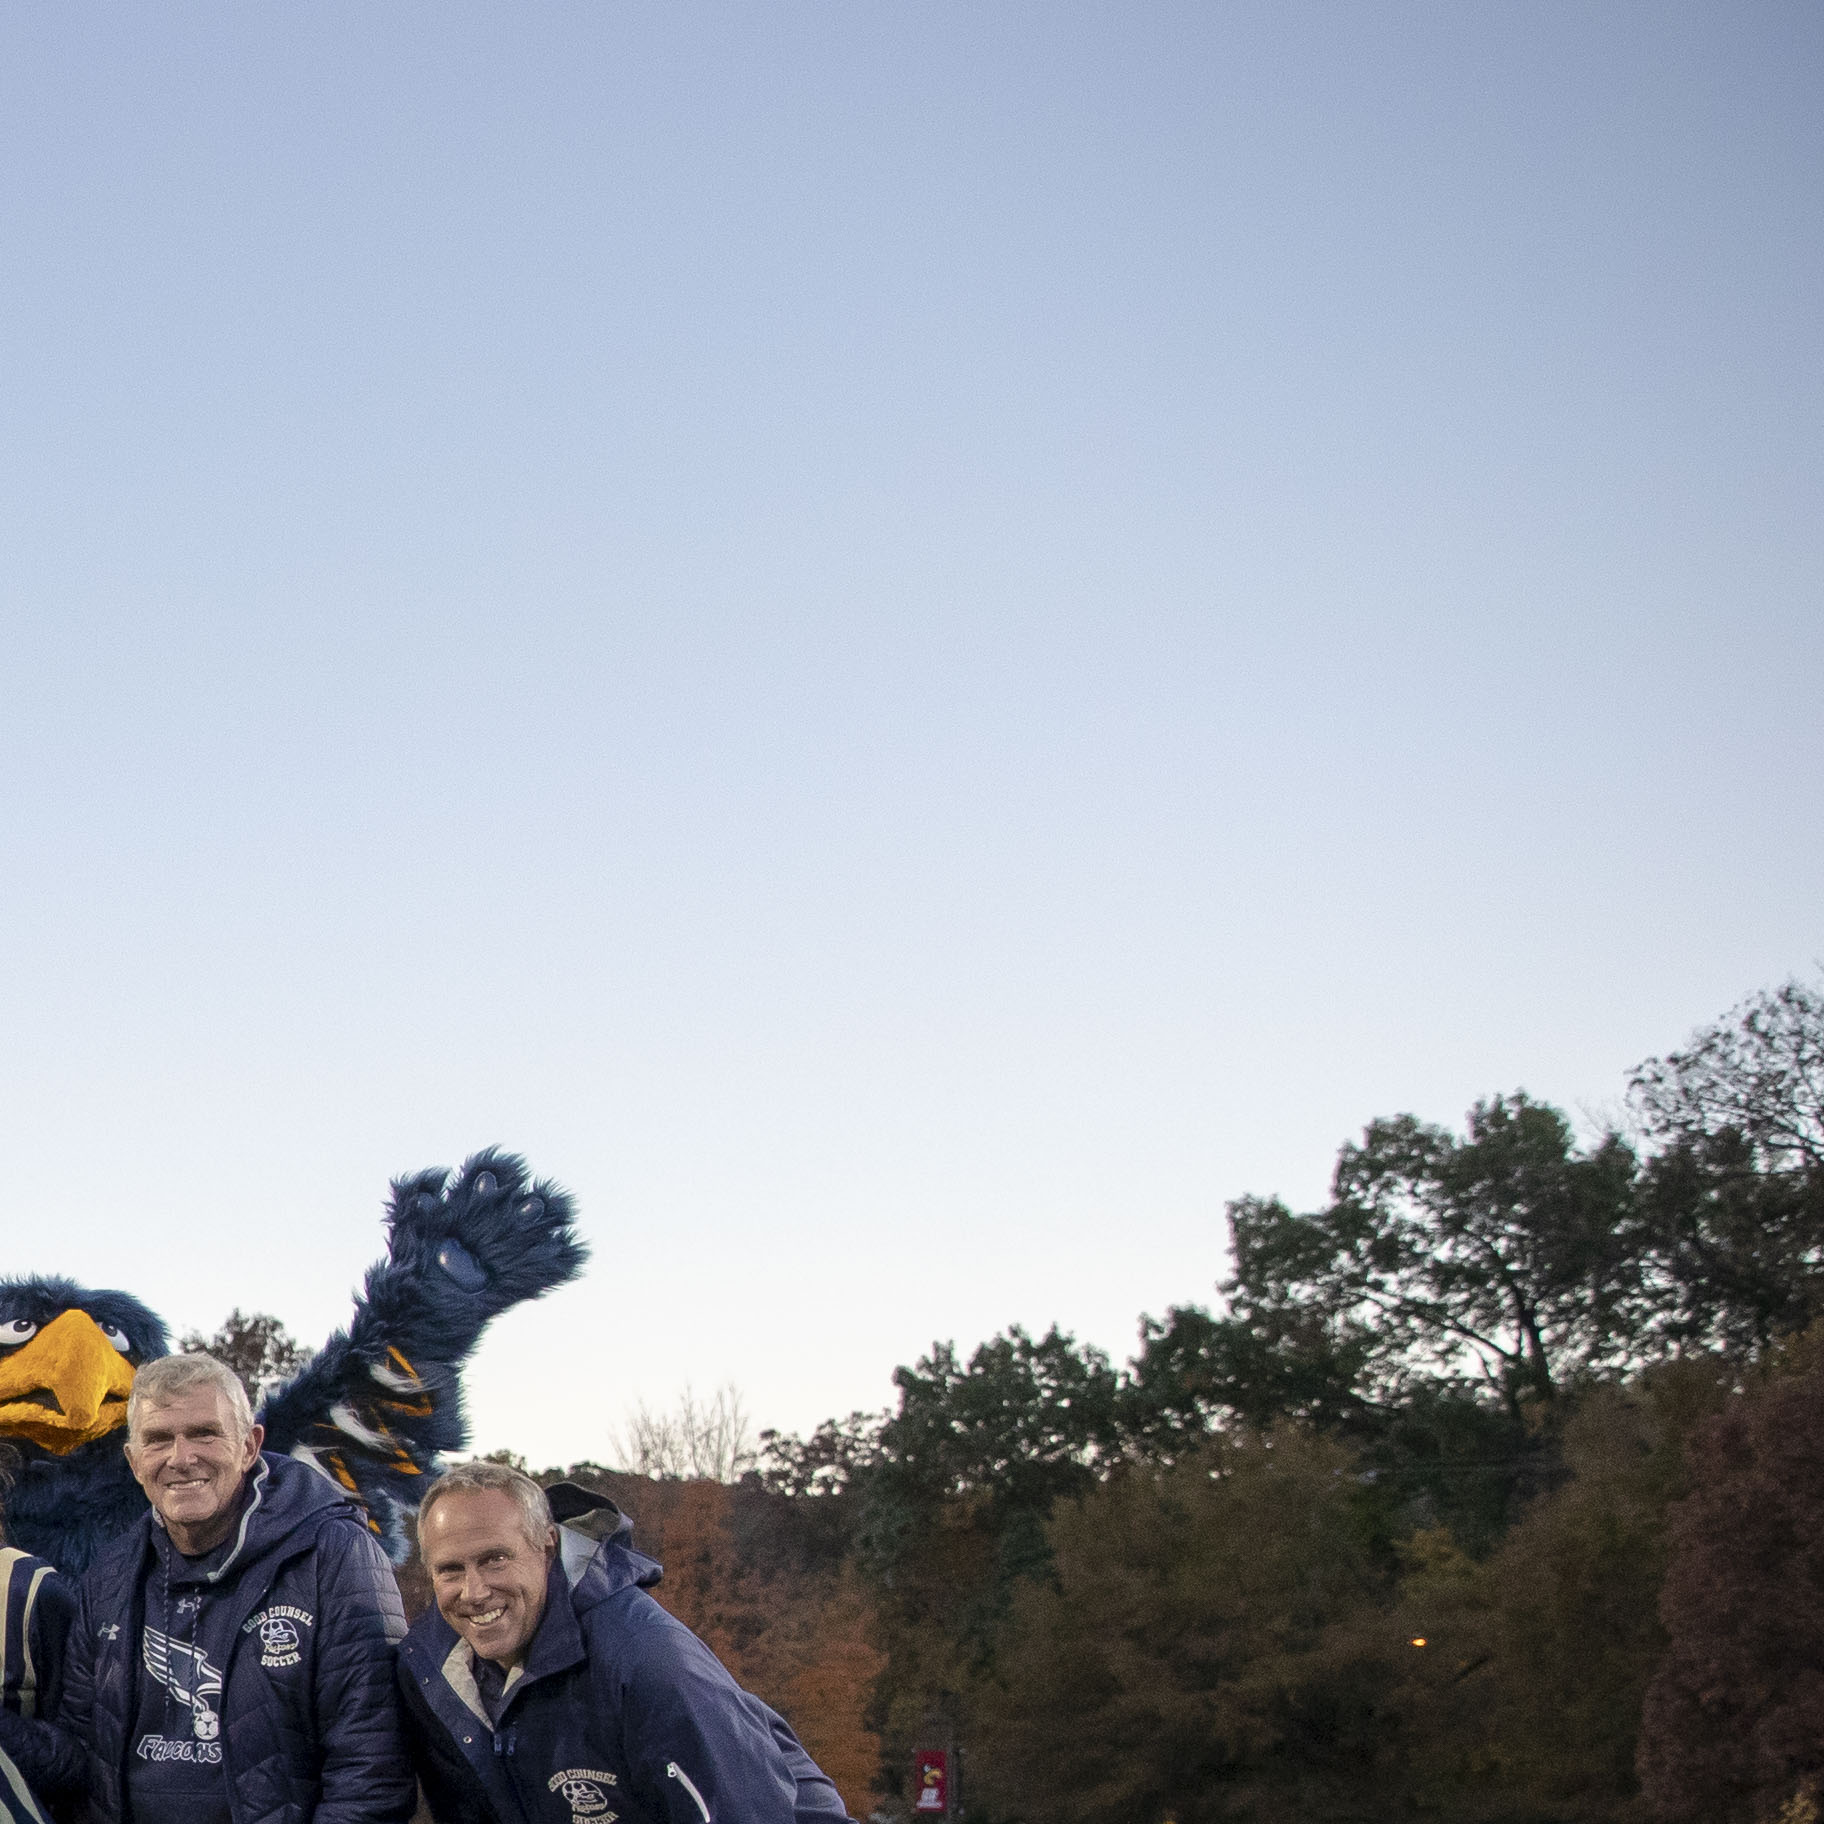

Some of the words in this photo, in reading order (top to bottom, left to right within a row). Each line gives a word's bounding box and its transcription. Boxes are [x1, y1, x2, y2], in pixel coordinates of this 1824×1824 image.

[242, 1611, 268, 1633] GOOD
[269, 1605, 314, 1627] COUNSEL
[260, 1651, 302, 1667] SOCCER
[137, 1735, 223, 1764] FALCONS
